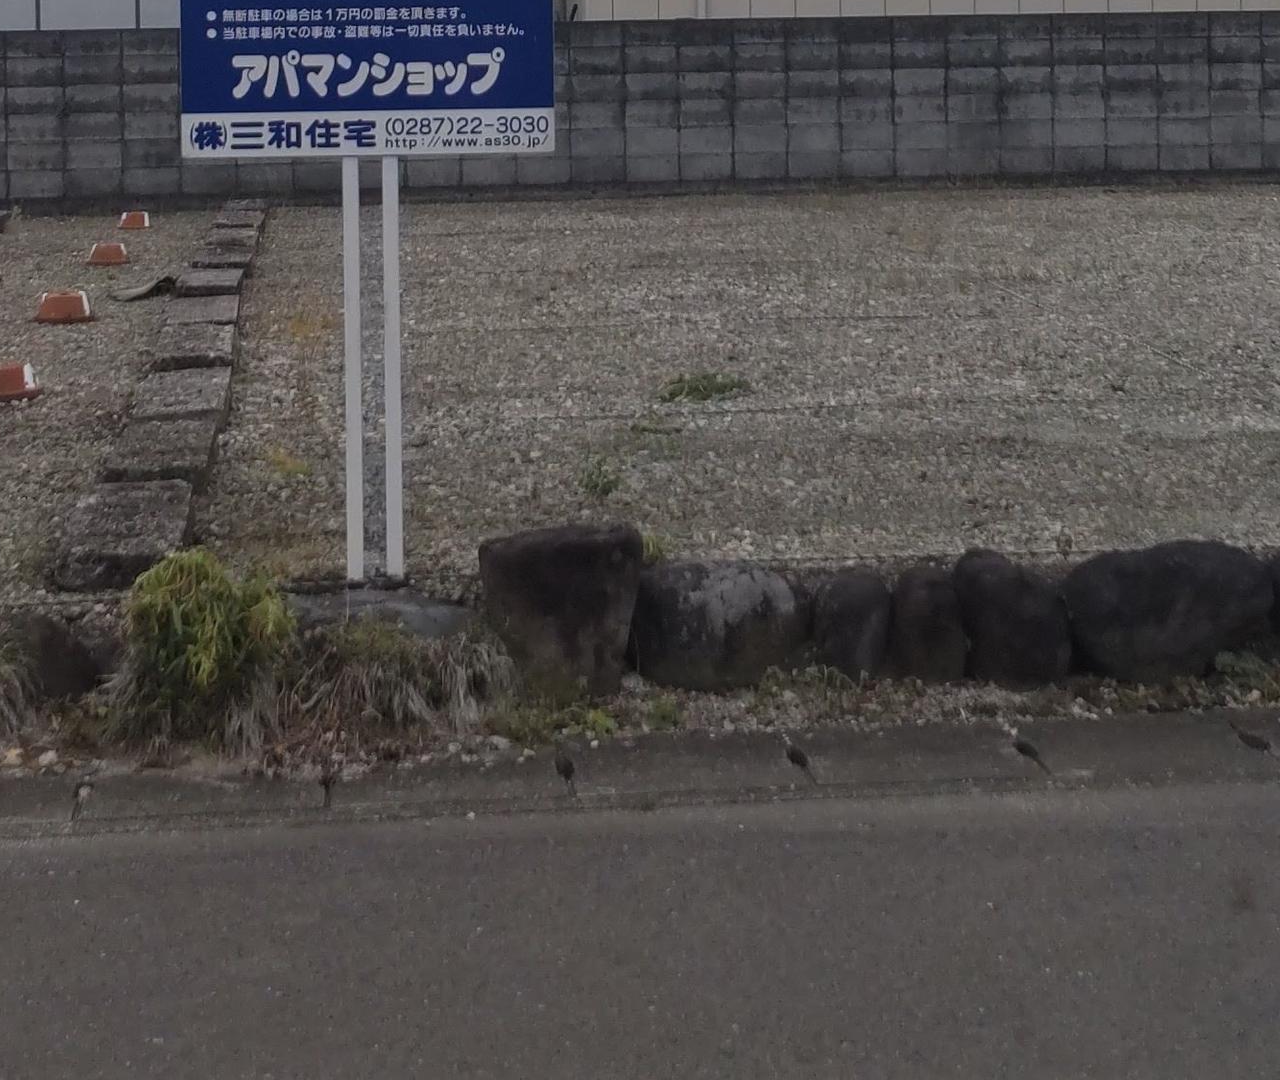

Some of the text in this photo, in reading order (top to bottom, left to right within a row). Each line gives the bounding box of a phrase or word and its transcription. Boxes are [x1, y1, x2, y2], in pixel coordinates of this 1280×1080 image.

[231, 47, 506, 100] アパマンショップ
[385, 116, 549, 136] (0287)22-3030
[385, 133, 549, 150] http://www.as30.jp/
